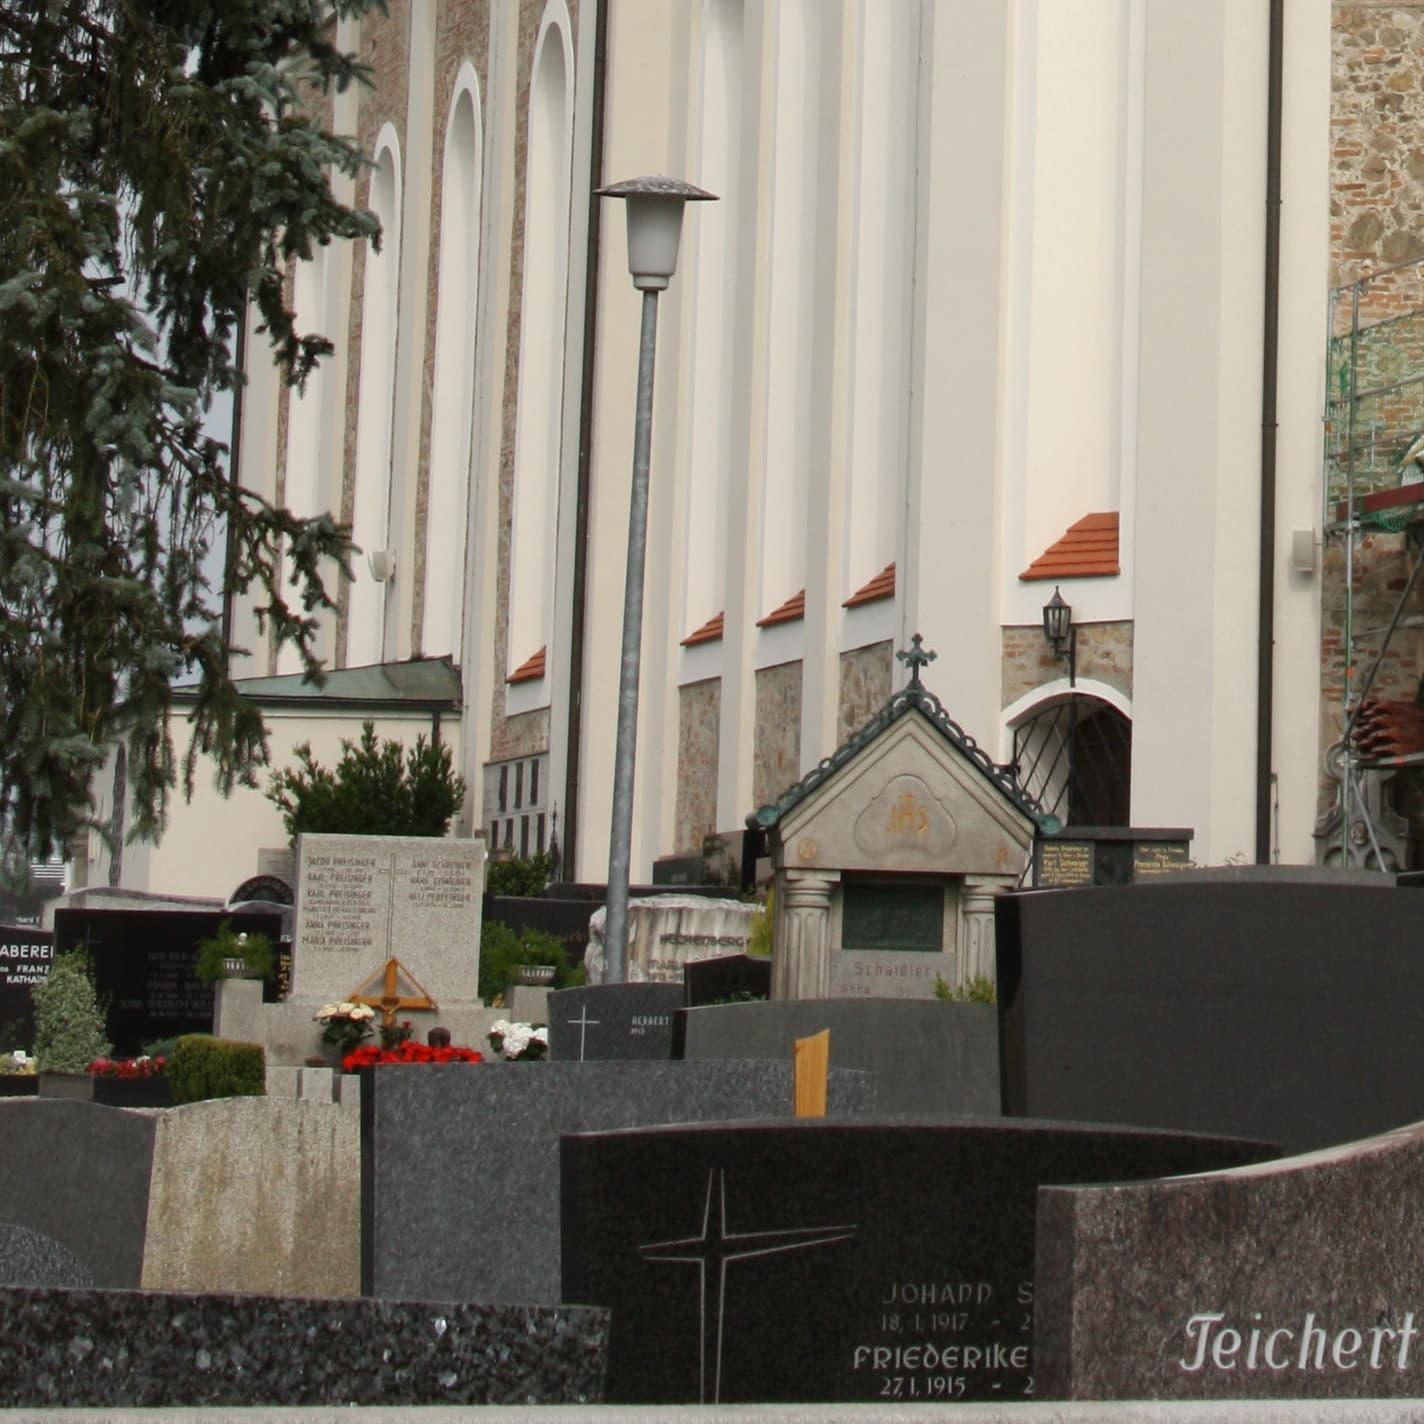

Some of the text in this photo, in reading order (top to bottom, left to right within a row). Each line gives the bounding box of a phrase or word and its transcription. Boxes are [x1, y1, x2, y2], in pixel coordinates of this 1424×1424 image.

[882, 1282, 993, 1304] JOHANN
[853, 1342, 1030, 1370] FRIEDERIKE
[1178, 1312, 1419, 1372] Teichert
